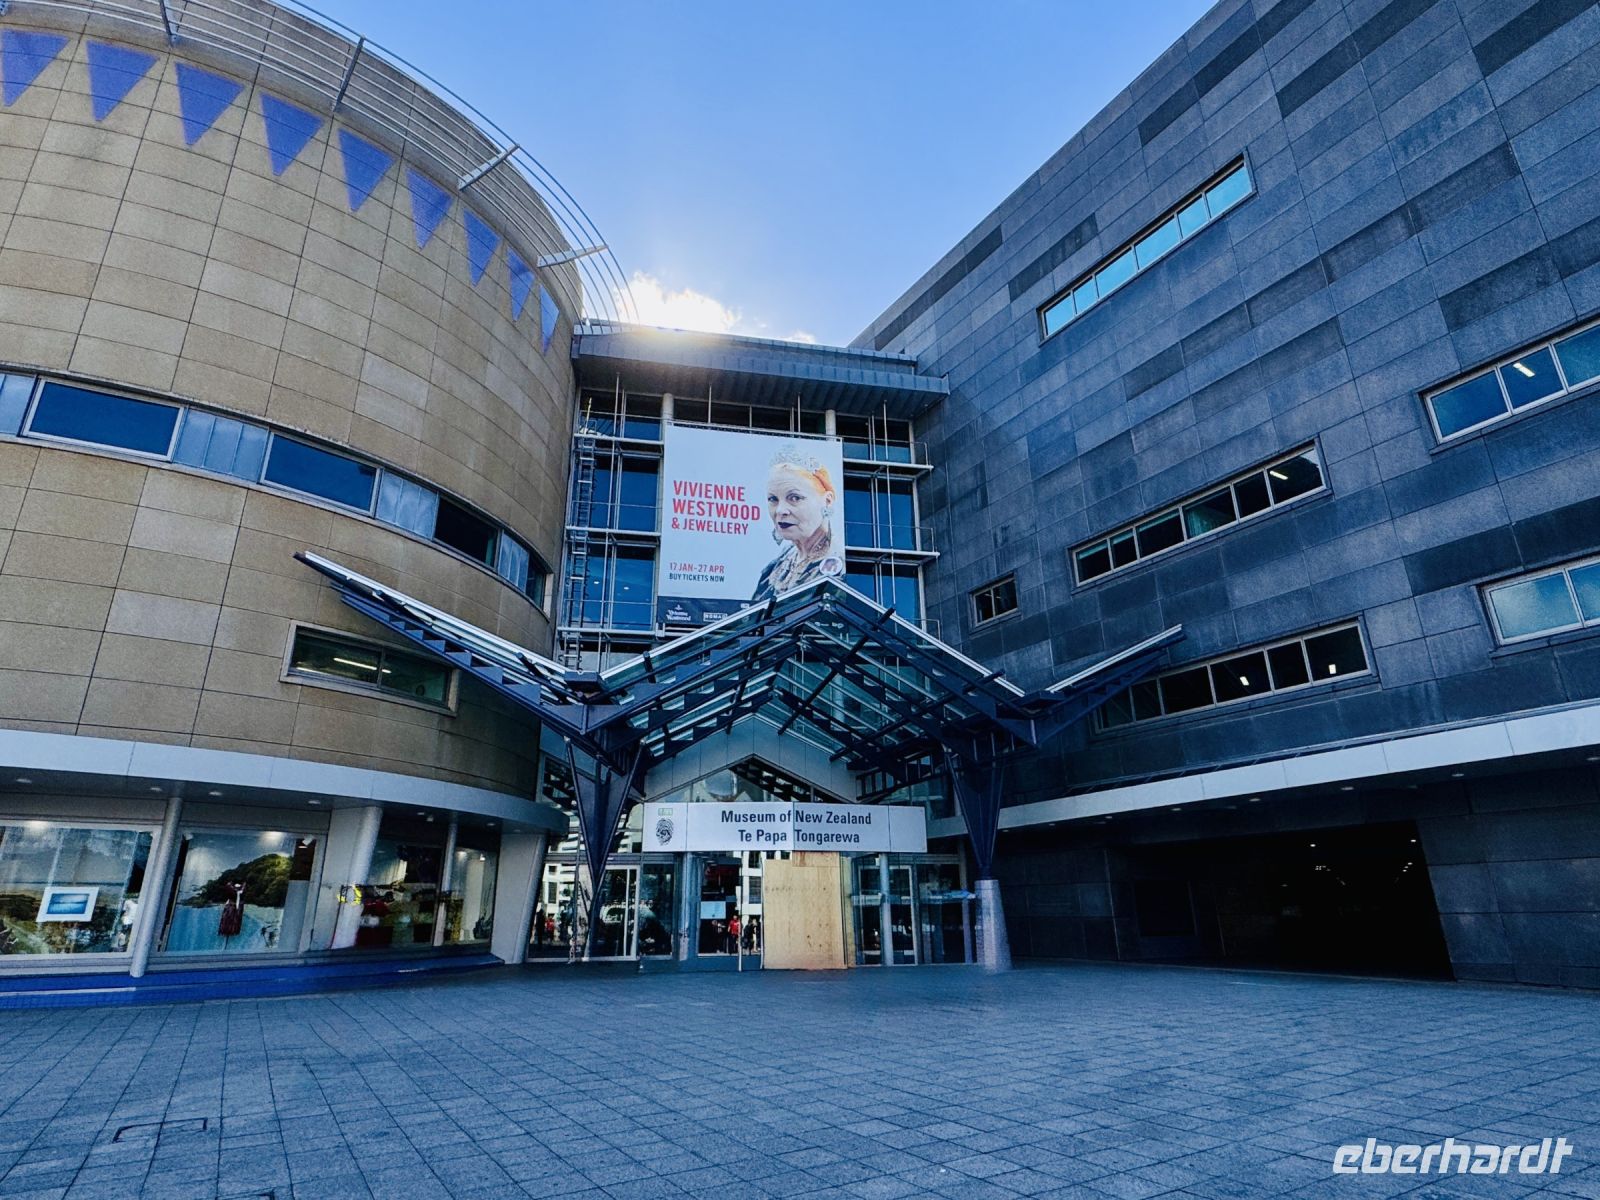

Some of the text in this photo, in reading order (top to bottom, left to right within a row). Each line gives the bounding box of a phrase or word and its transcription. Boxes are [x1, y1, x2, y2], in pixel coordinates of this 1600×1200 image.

[673, 480, 745, 502] VIVIENNE
[672, 498, 760, 521] WESTWOOD
[671, 517, 748, 535] & JEWELLERY
[670, 562, 677, 571] 17
[679, 563, 693, 572] JAN
[698, 564, 707, 573] 27
[709, 565, 725, 574] APR
[682, 574, 708, 582] TICKETS
[709, 575, 725, 583] NOW
[721, 810, 872, 825] Museum of New Zealand
[738, 829, 860, 845] Te Papa Tongarewa
